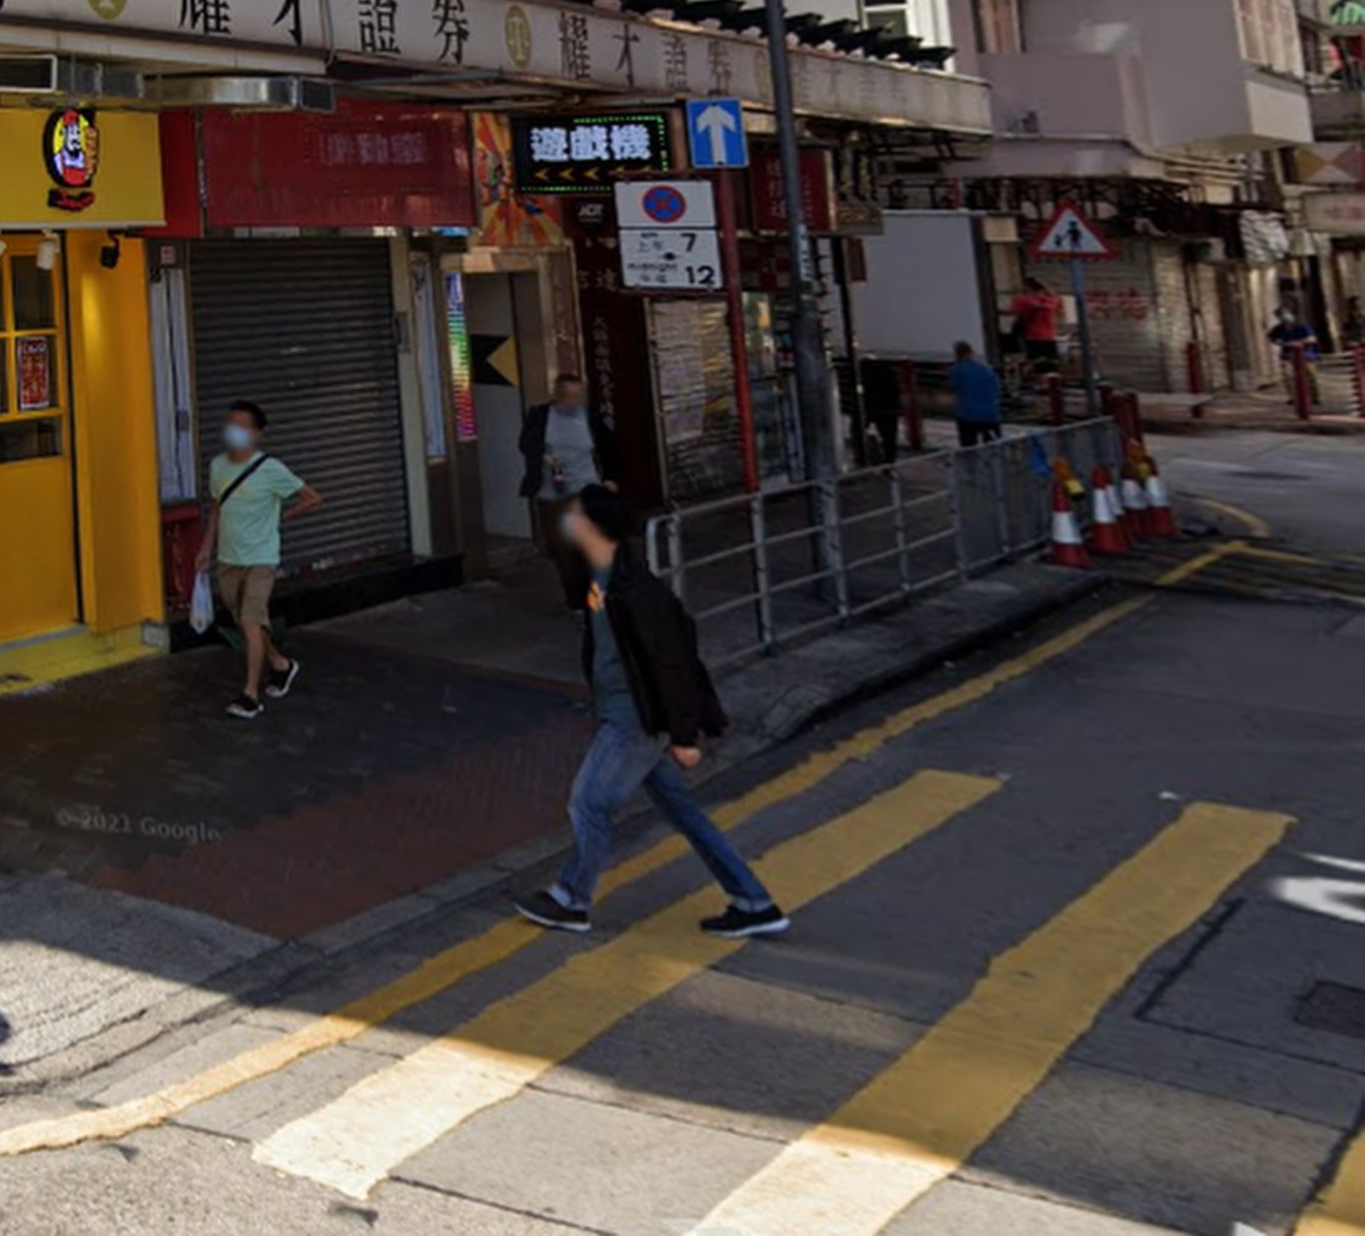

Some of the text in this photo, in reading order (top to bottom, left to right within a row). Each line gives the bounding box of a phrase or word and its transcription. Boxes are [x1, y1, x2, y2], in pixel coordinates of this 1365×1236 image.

[530, 124, 652, 163] 遊戲機
[680, 233, 697, 252] 7
[684, 265, 716, 285] 12
